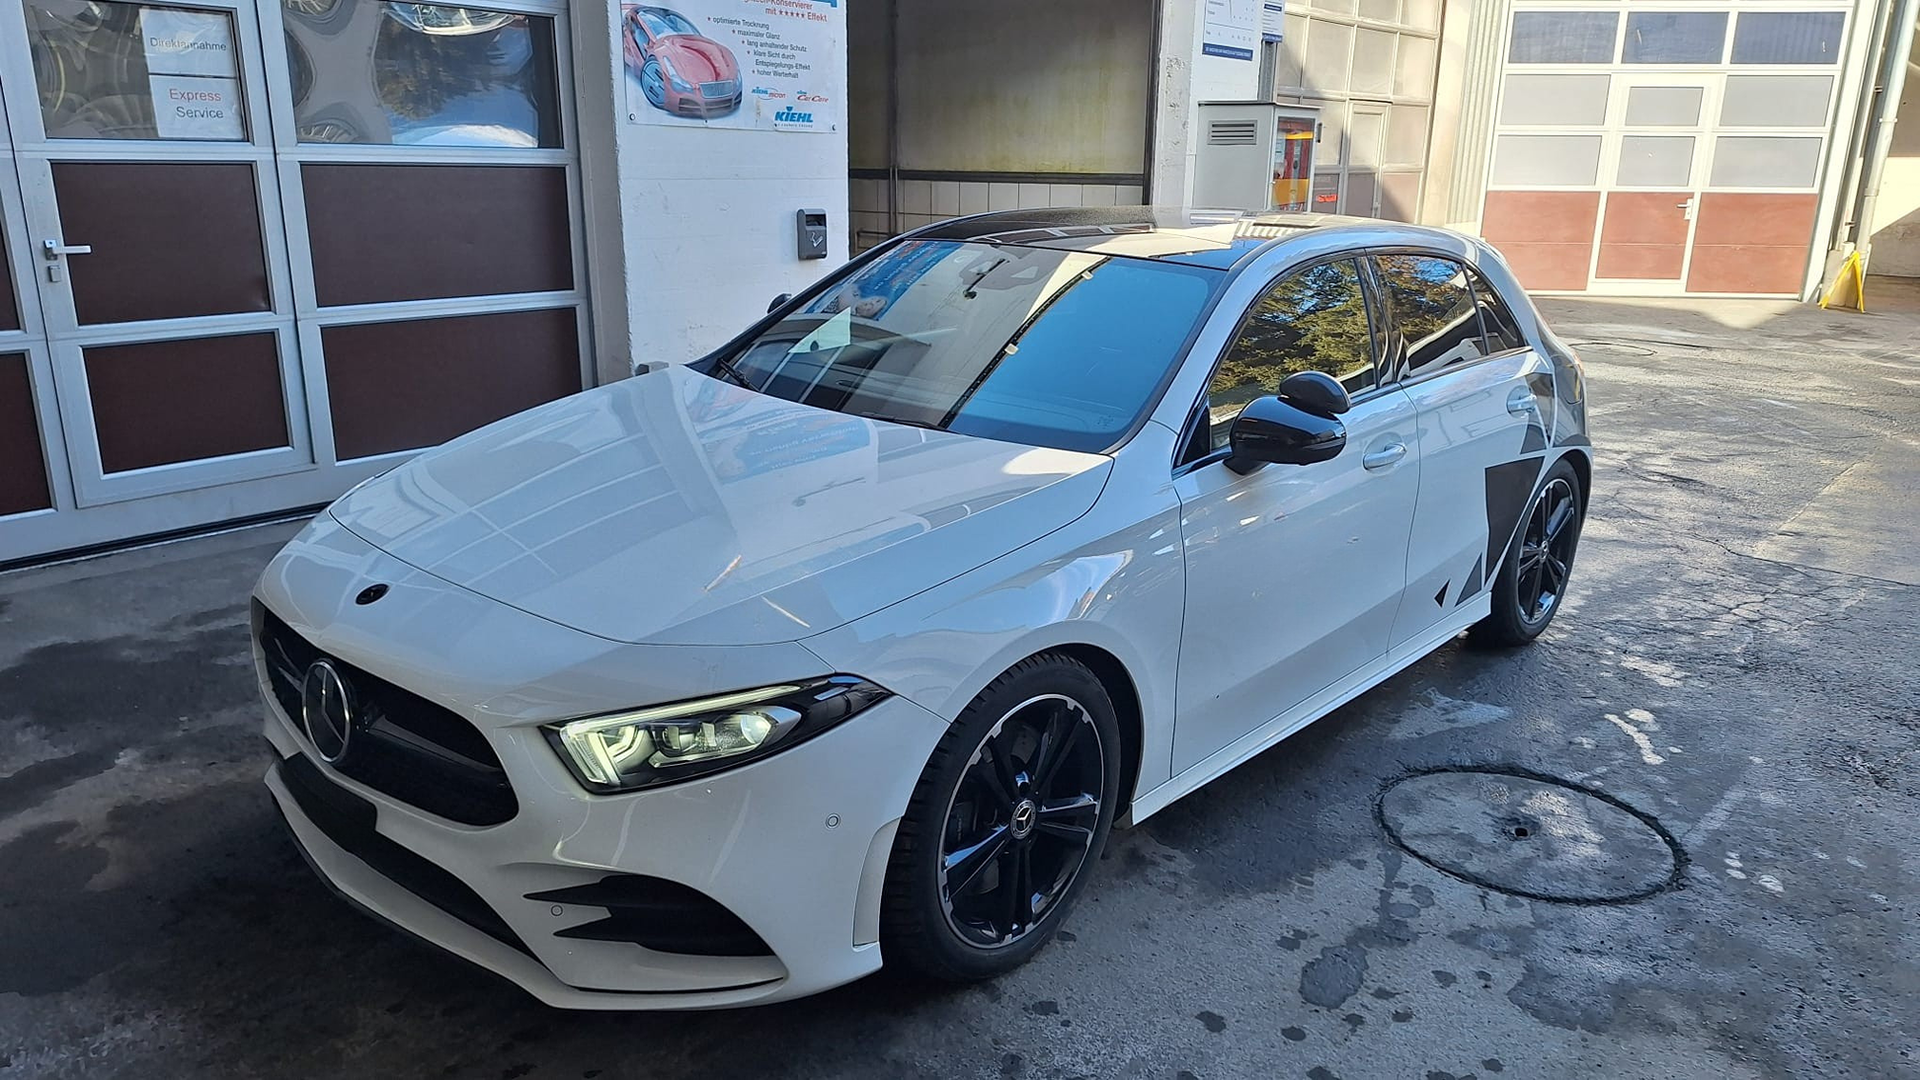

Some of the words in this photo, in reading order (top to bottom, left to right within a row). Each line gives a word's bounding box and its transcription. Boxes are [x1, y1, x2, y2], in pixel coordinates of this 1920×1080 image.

[765, 7, 777, 15] mit
[807, 12, 827, 21] Effekt
[742, 19, 770, 30] Trocknung
[737, 29, 765, 38] maximaler
[766, 32, 780, 40] Glanz
[150, 37, 227, 51] Direktannahme
[747, 39, 758, 48] lang
[790, 44, 807, 52] Schutz
[169, 88, 222, 102] Express
[176, 106, 224, 119] Service
[775, 106, 813, 123] KIEHL
